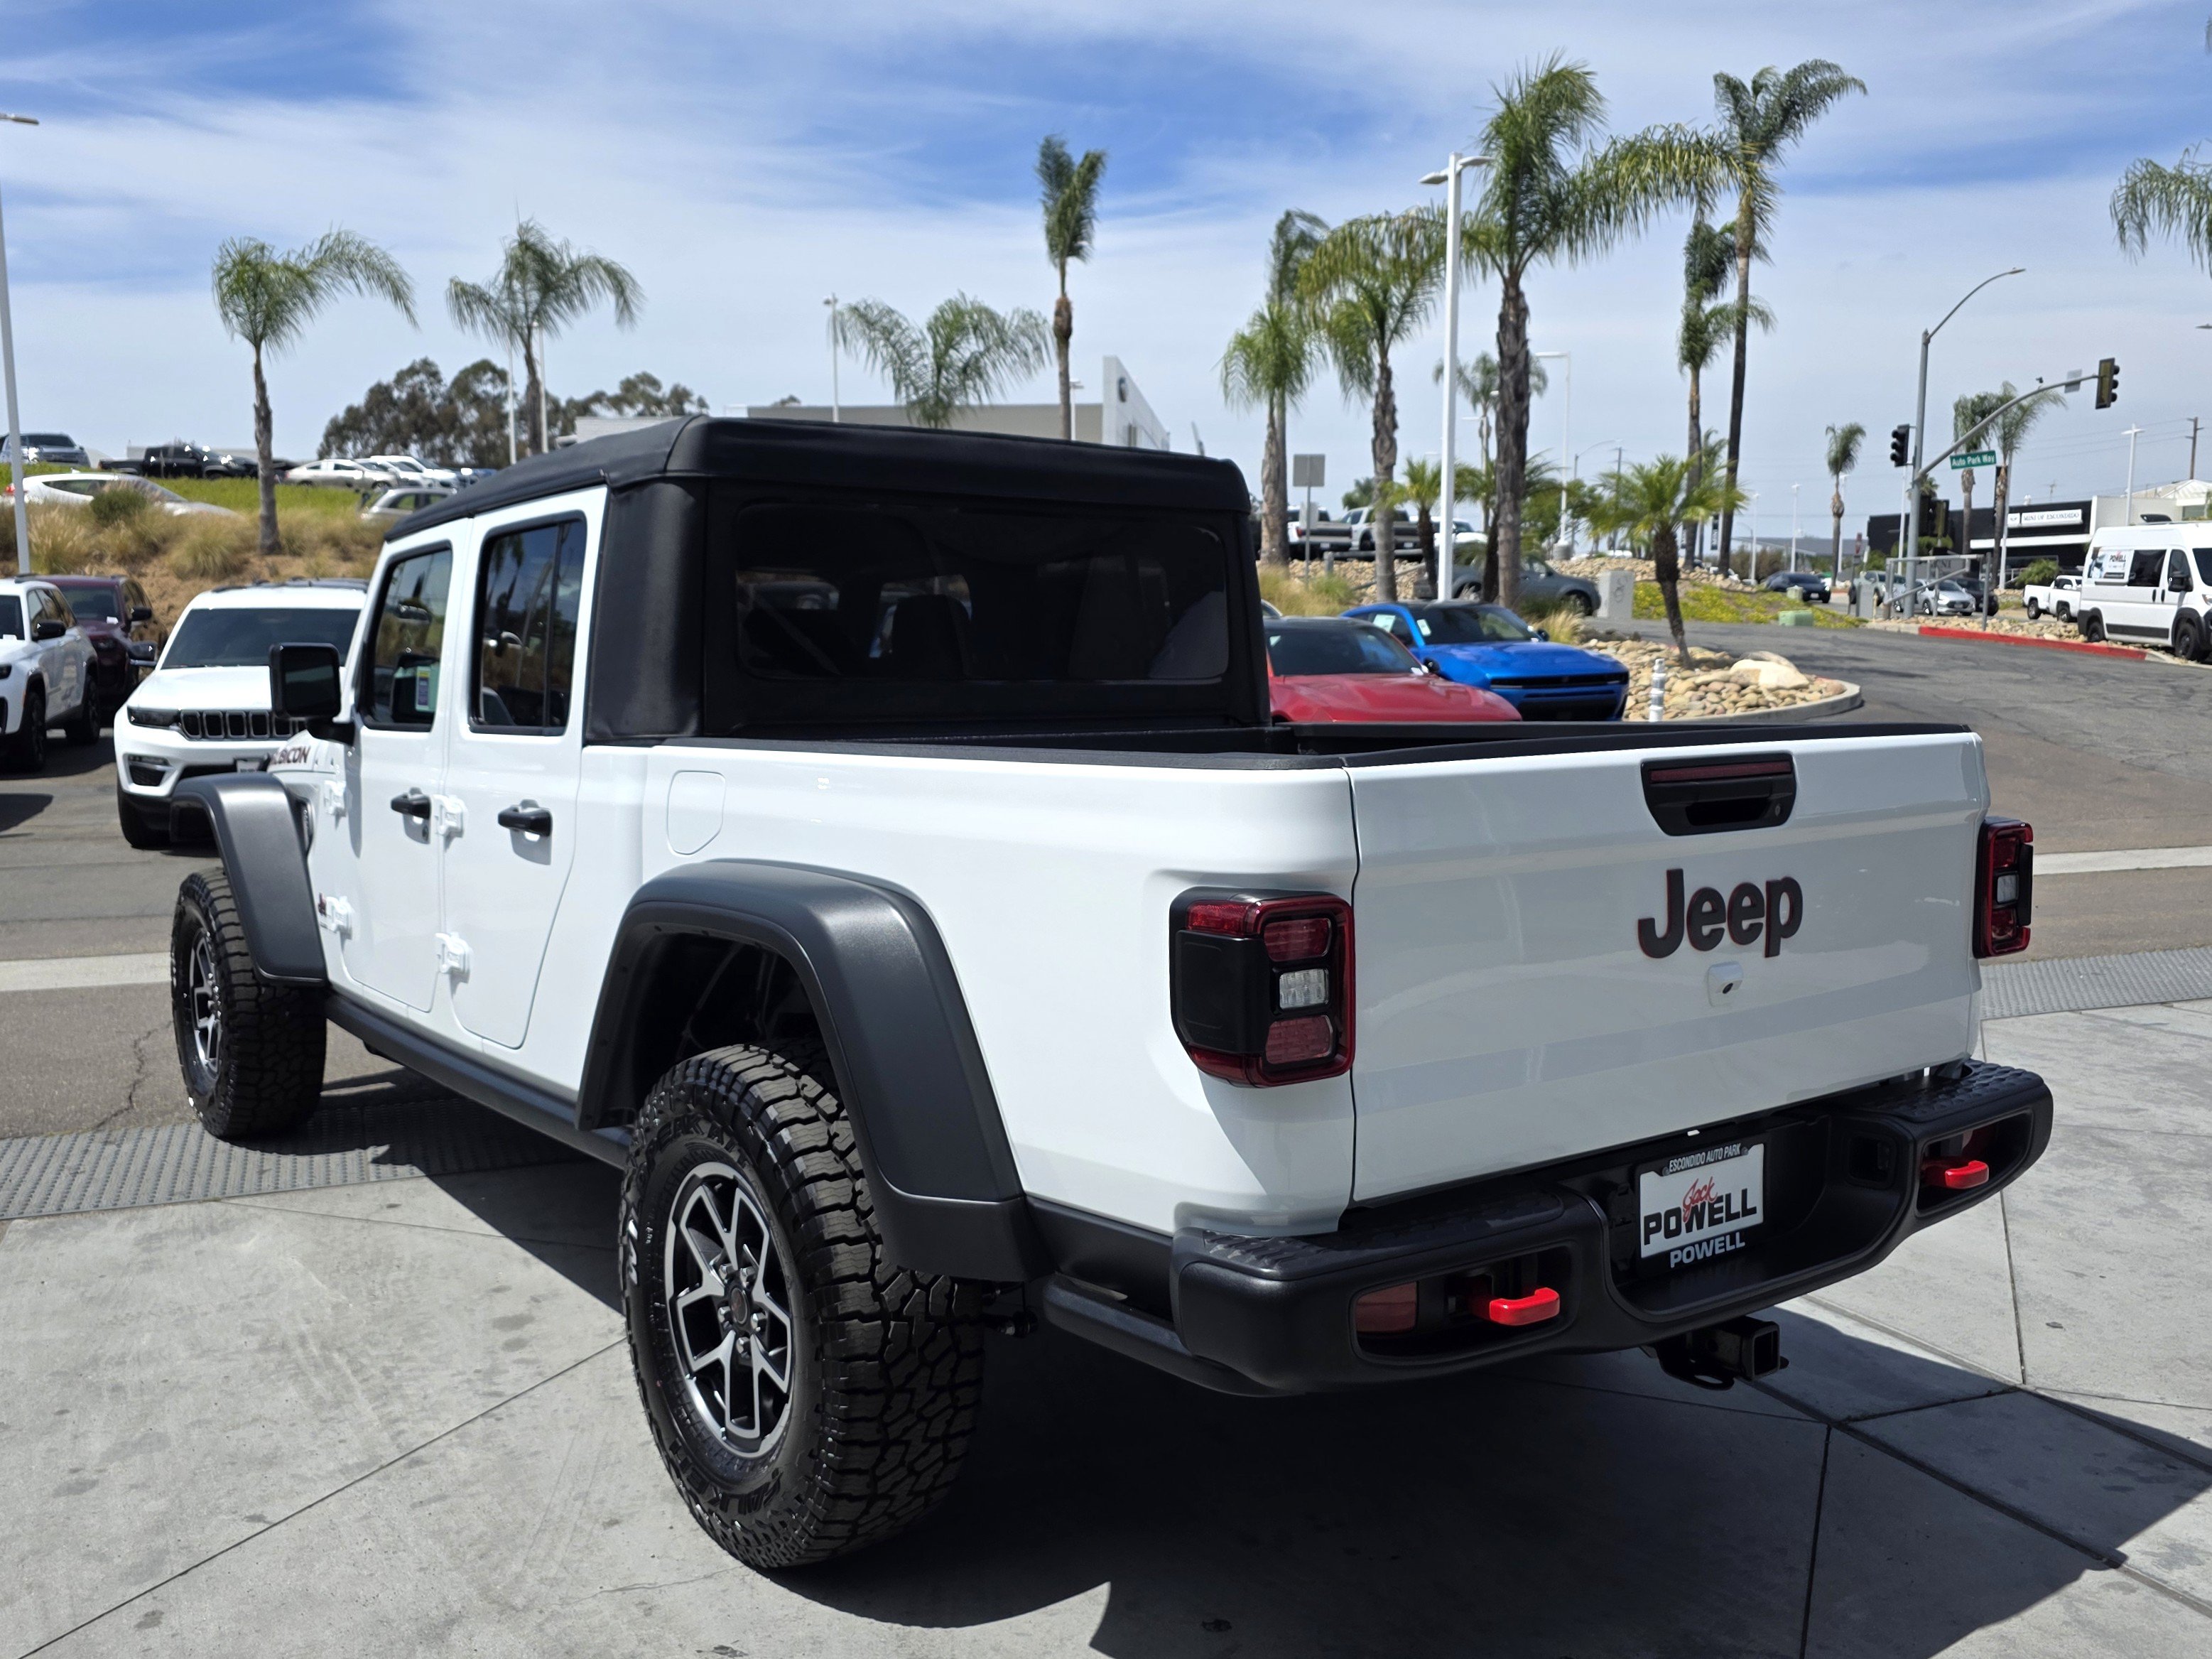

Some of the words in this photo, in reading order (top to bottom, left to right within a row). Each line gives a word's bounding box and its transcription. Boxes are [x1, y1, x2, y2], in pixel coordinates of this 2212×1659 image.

[1952, 458, 1966, 466] Auto
[1967, 455, 1980, 465] Park
[1982, 454, 1995, 464] Way
[1638, 868, 1803, 958] Jeep
[1669, 1152, 1706, 1172] ESCONDIDO
[1706, 1148, 1723, 1162] AUTO
[1724, 1143, 1741, 1158] PARK
[1644, 1188, 1757, 1245] POWELL
[1683, 1177, 1718, 1223] Jack
[1670, 1231, 1745, 1268] POWELL
